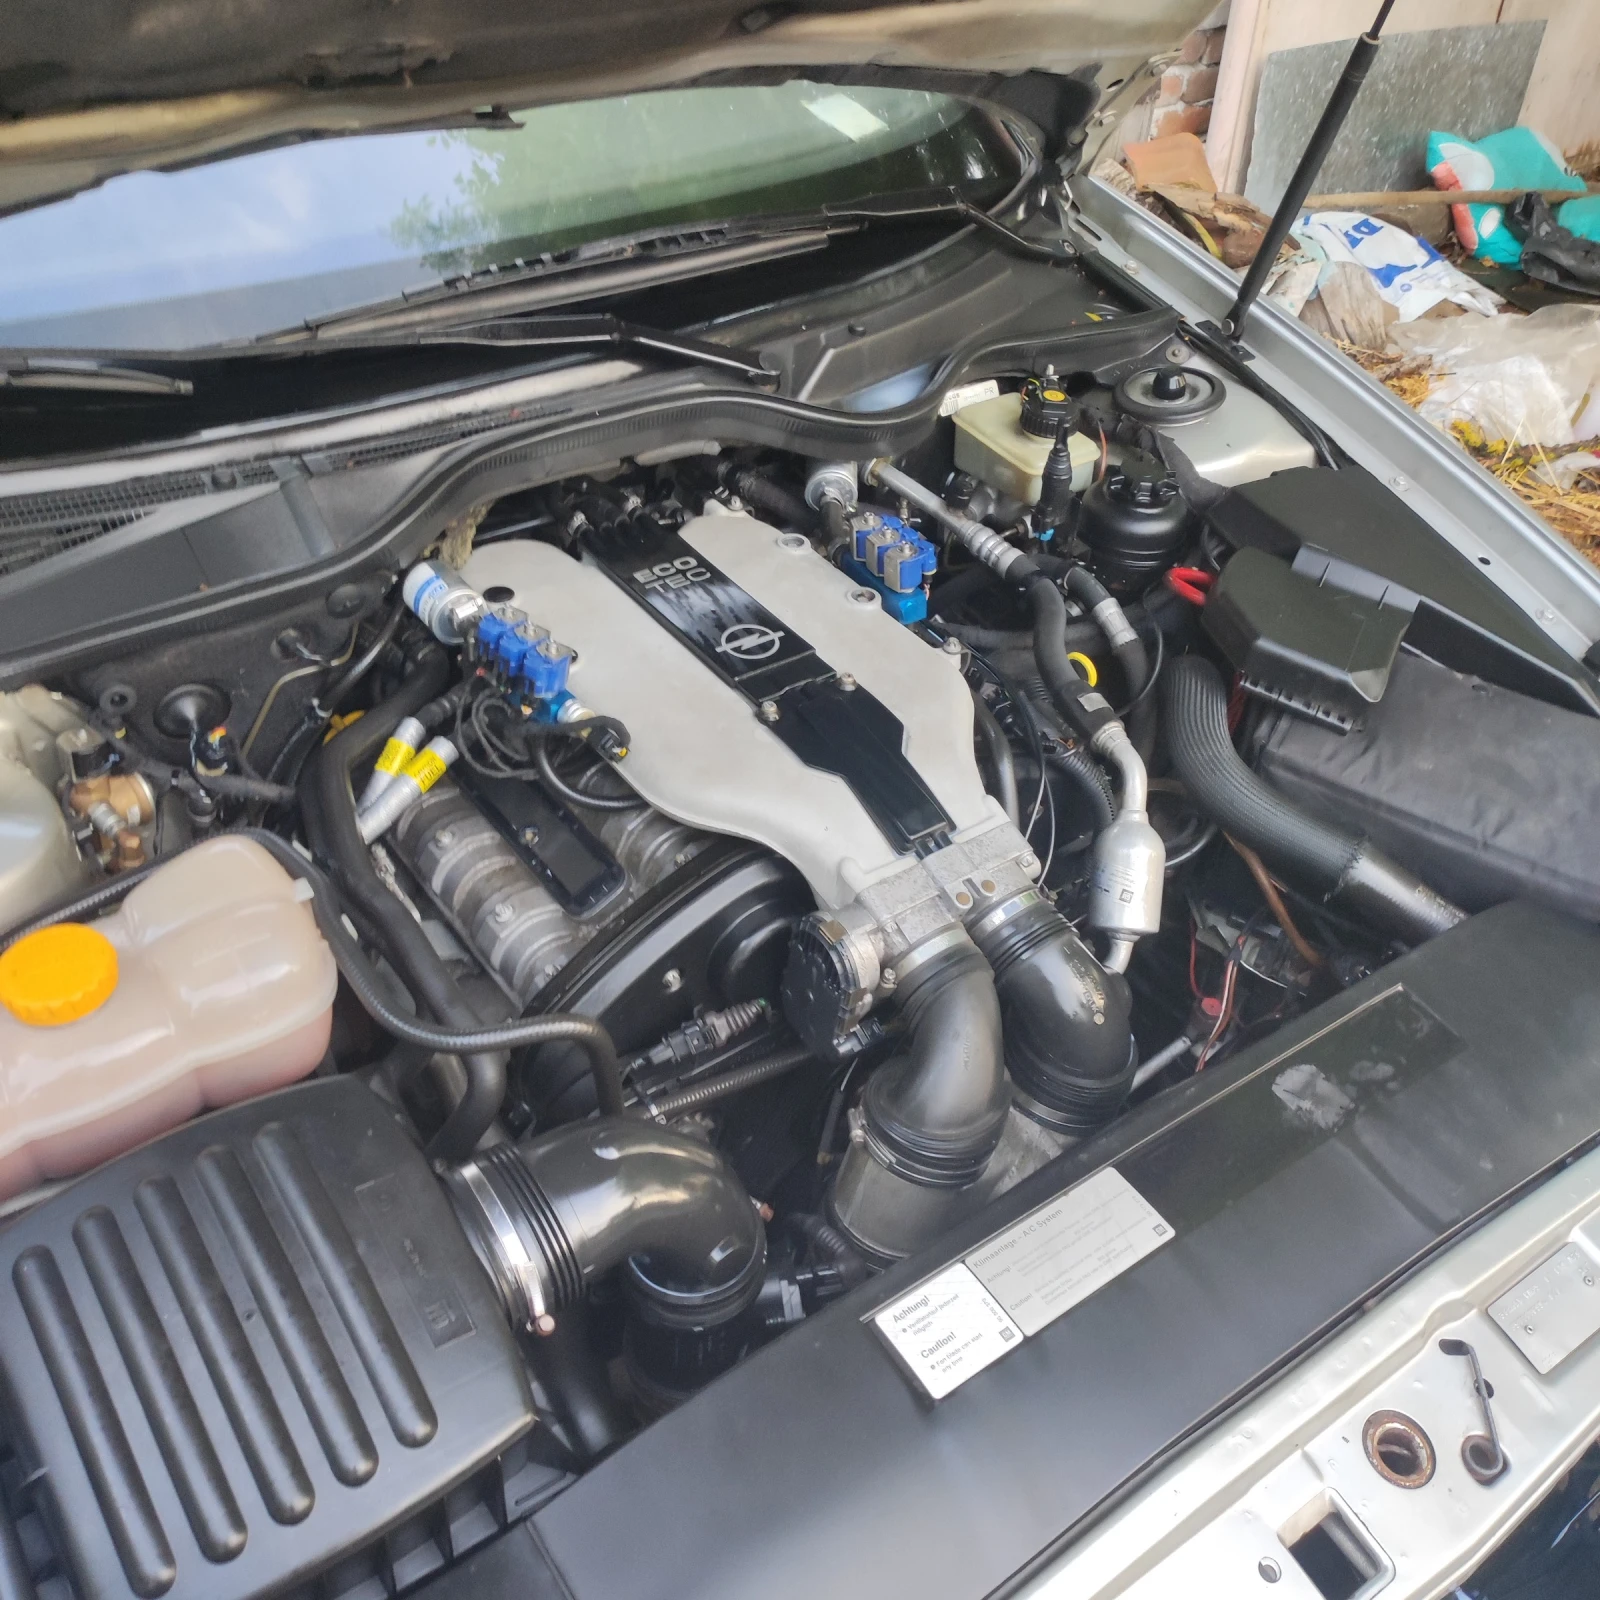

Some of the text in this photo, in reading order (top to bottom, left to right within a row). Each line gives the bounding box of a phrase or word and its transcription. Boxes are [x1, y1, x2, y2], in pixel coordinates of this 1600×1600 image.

[632, 555, 698, 584] ECO
[644, 567, 712, 593] TEC
[973, 1238, 1017, 1269] Klimaanlage
[1022, 1225, 1037, 1238] A/C
[1036, 1209, 1063, 1229] System
[986, 1265, 1012, 1284] Achtung!
[892, 1295, 931, 1323] Achtung!
[1009, 1293, 1033, 1311] Caution!
[920, 1332, 957, 1358] Caution!
